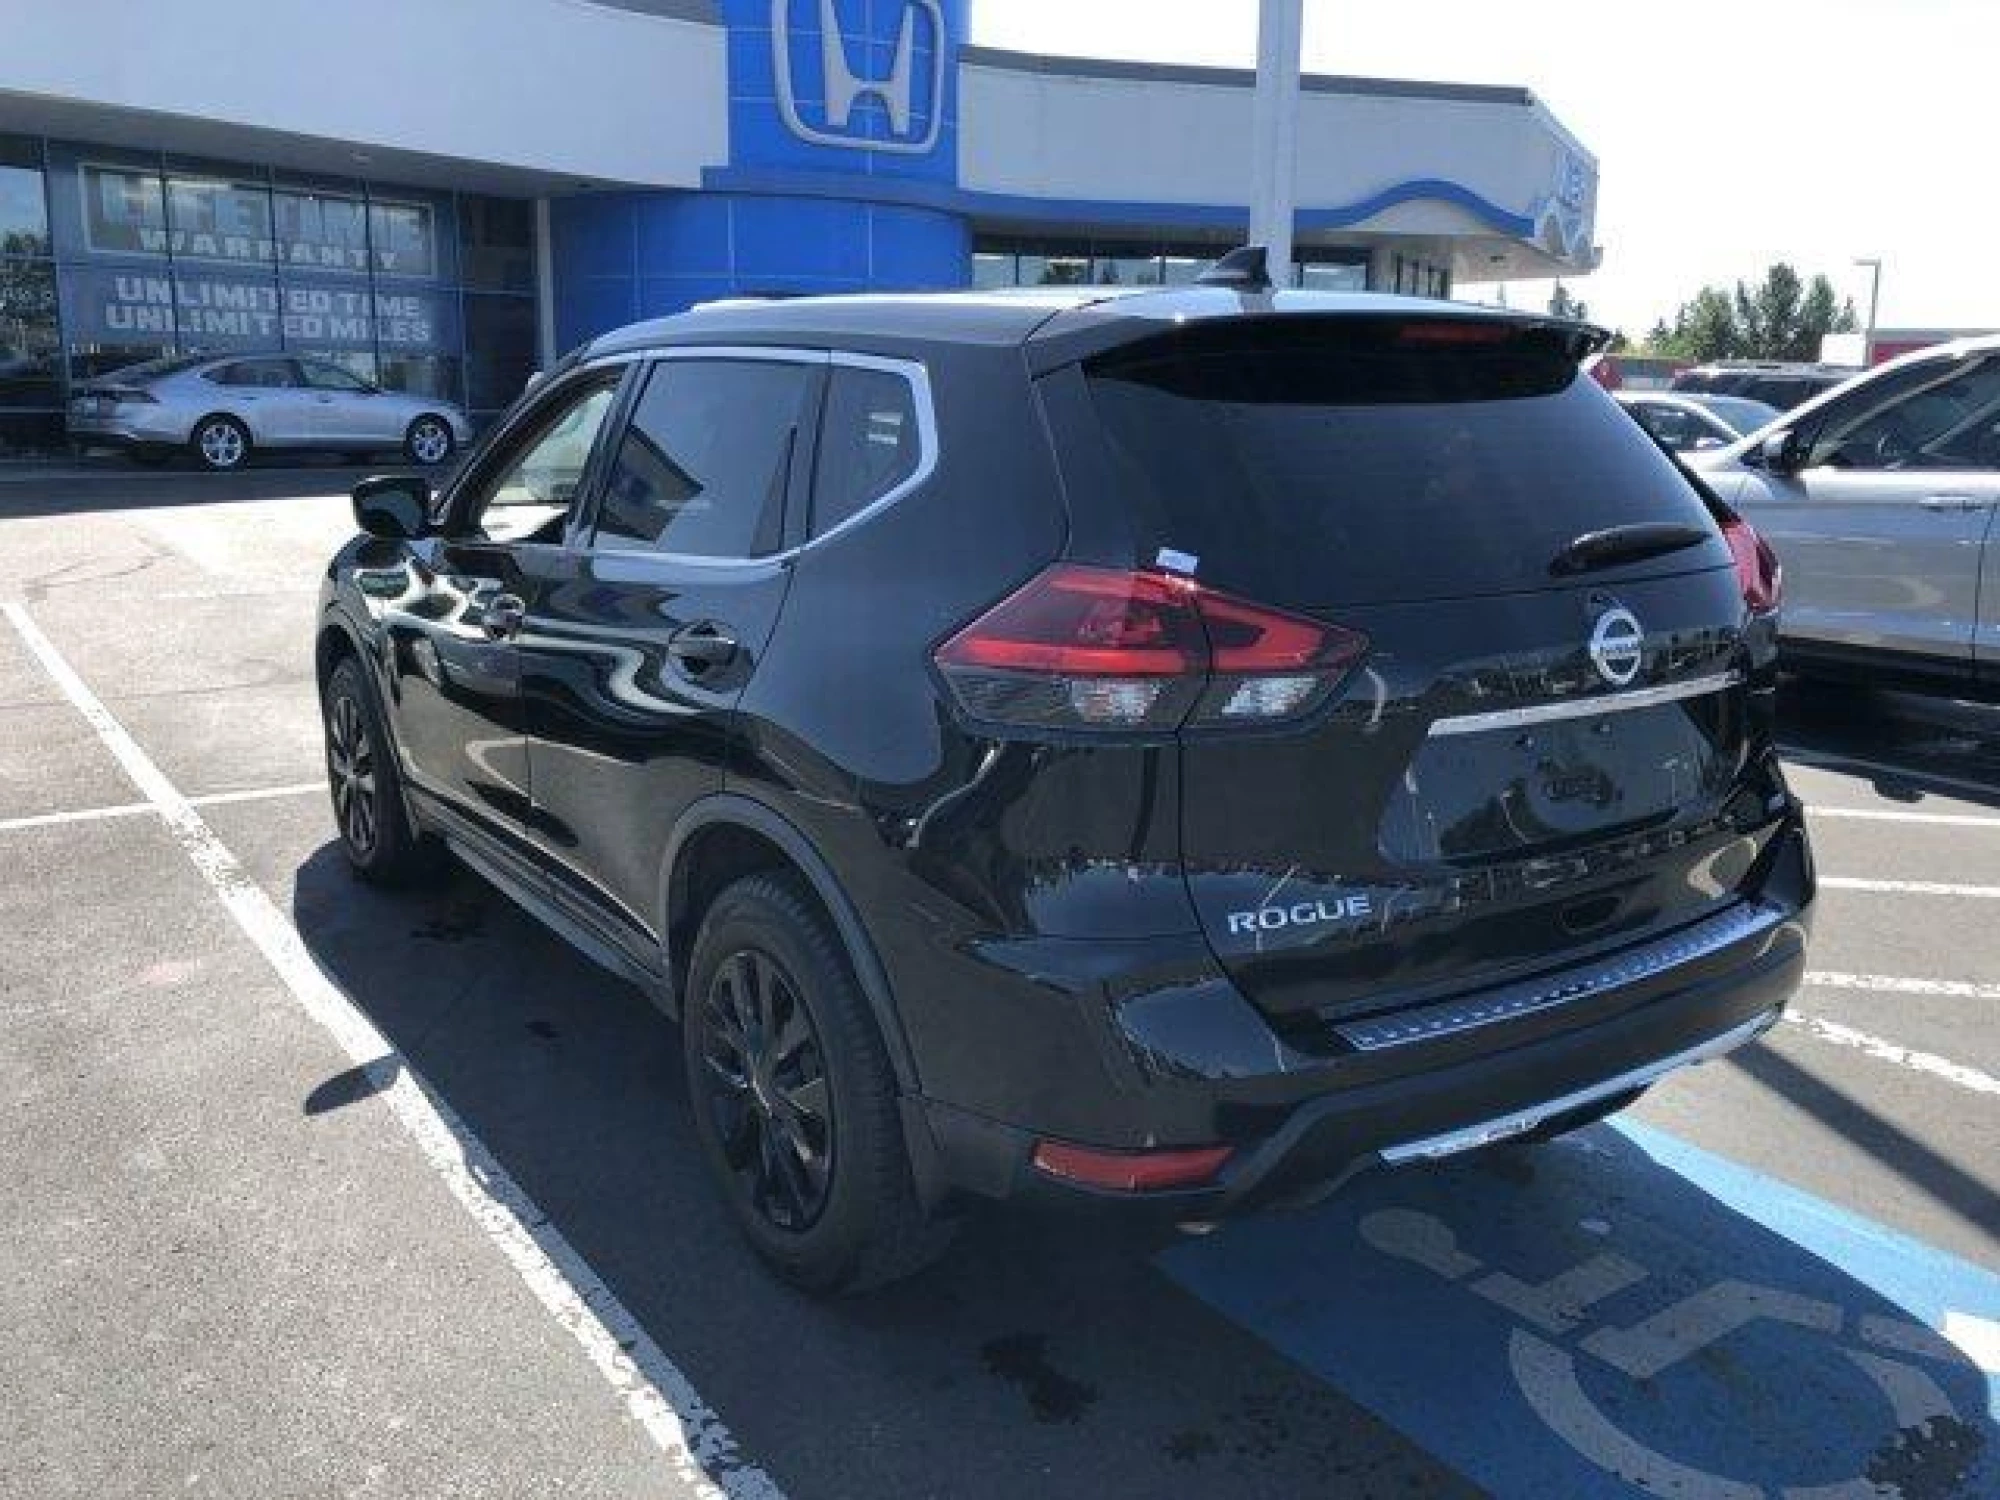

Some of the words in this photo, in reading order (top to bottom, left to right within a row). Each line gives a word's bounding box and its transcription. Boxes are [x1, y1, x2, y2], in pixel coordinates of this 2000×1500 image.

[139, 228, 399, 269] WARRANTY
[115, 277, 329, 314] UNLIMITED
[337, 292, 420, 318] TIME
[105, 305, 322, 339] UNLIMITED
[330, 314, 431, 342] MILES
[1227, 896, 1373, 933] ROGUE
